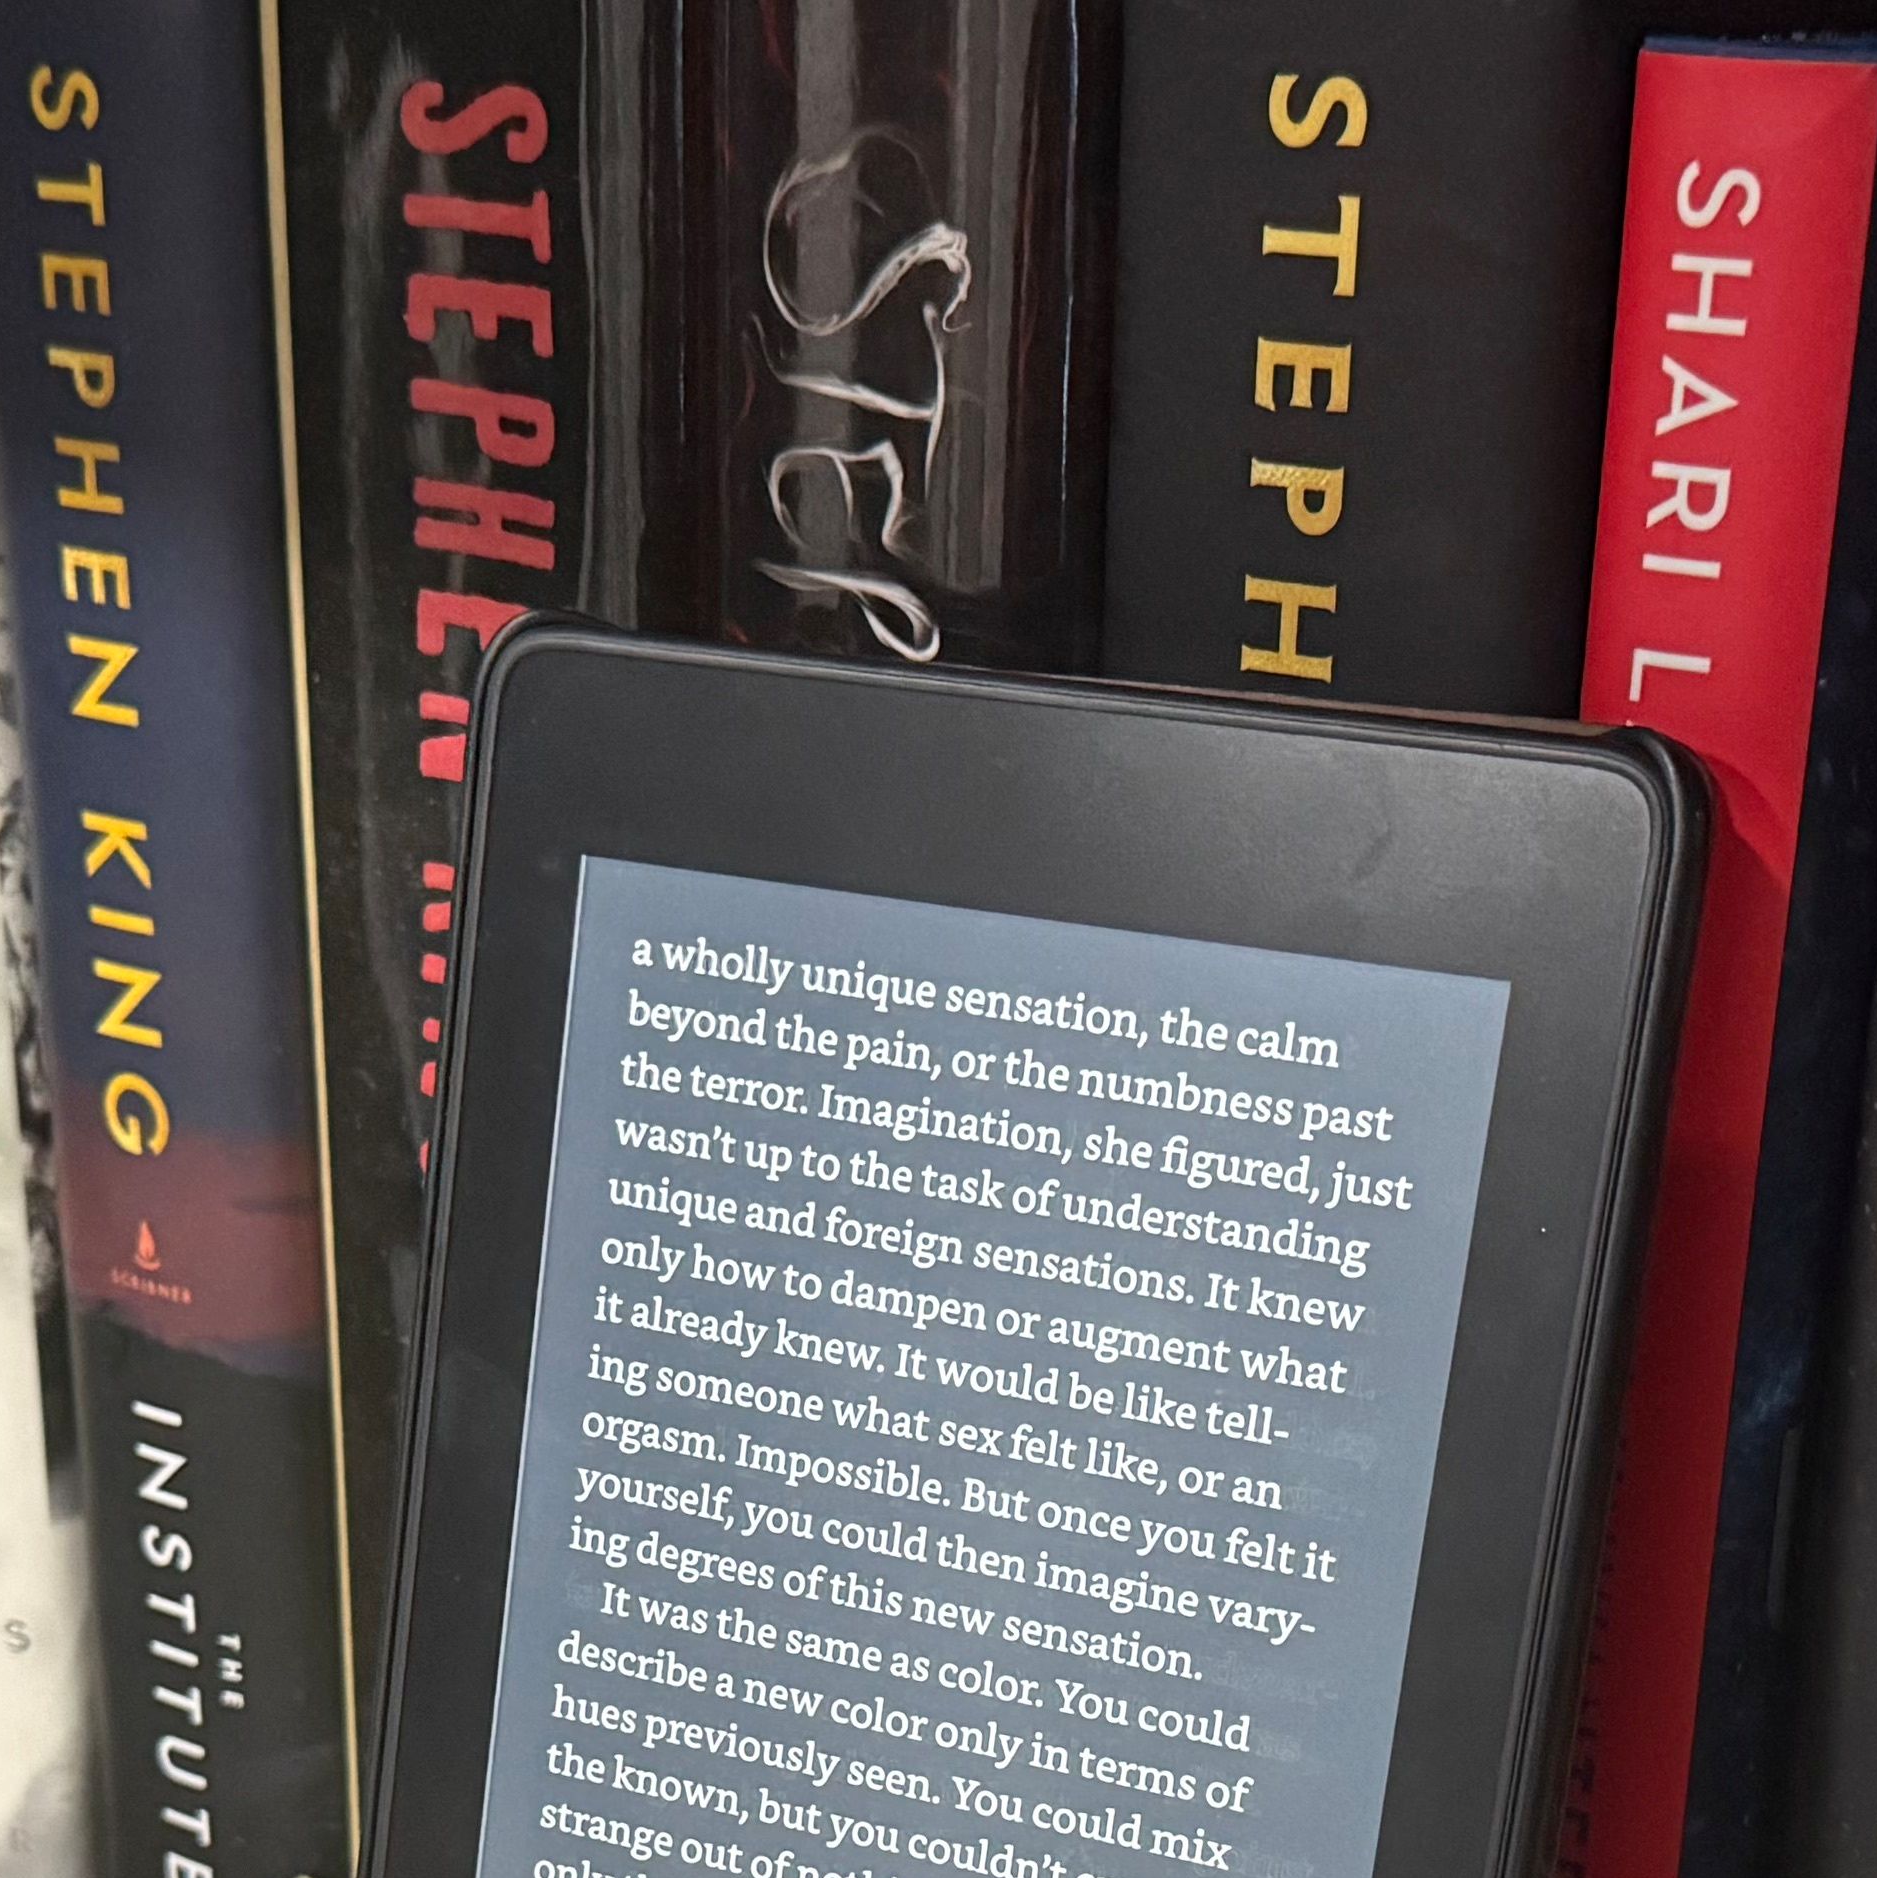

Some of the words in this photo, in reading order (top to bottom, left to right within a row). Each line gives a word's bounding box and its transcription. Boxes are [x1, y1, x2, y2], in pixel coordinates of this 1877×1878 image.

[29, 65, 140, 729] STEPHEN
[1640, 160, 1763, 580] SHARI
[1625, 648, 1712, 725] L
[80, 809, 170, 1157] KING
[630, 937, 654, 967] a
[660, 935, 795, 996] wholly
[799, 959, 937, 1013] unique
[944, 984, 1148, 1049] sensation,
[1158, 1005, 1229, 1051] the
[1235, 1020, 1339, 1068] calm
[619, 1049, 682, 1094] the
[688, 1064, 808, 1115] terror.
[816, 1082, 1072, 1165] Imagination,
[1082, 1123, 1153, 1169] she
[1158, 1133, 1320, 1204] figured,
[1323, 1159, 1414, 1210] just
[627, 987, 767, 1046] beyond
[773, 1012, 839, 1057] the
[842, 1028, 942, 1081] pain,
[950, 1048, 997, 1081] or
[1002, 1047, 1070, 1092] the
[1076, 1067, 1294, 1126] numbness
[1297, 1100, 1394, 1142] past
[743, 1139, 793, 1182] up
[799, 1143, 841, 1182] to
[848, 1148, 913, 1194] the
[920, 1163, 1006, 1209] task
[1011, 1177, 1061, 1217] of
[1060, 1191, 1371, 1279] understanding
[600, 1233, 686, 1283] only
[688, 1241, 777, 1291] how
[781, 1263, 823, 1301] to
[829, 1268, 987, 1331] dampen
[995, 1307, 1042, 1340] or
[1046, 1316, 1231, 1374] augment
[1238, 1344, 1348, 1394] what
[572, 1466, 735, 1531] yourself,
[739, 1500, 814, 1540] you
[821, 1517, 928, 1563] could
[934, 1532, 1026, 1584] then
[1032, 1549, 1199, 1618] imagine
[1206, 1593, 1316, 1646] vary-
[217, 1633, 244, 1708] THE
